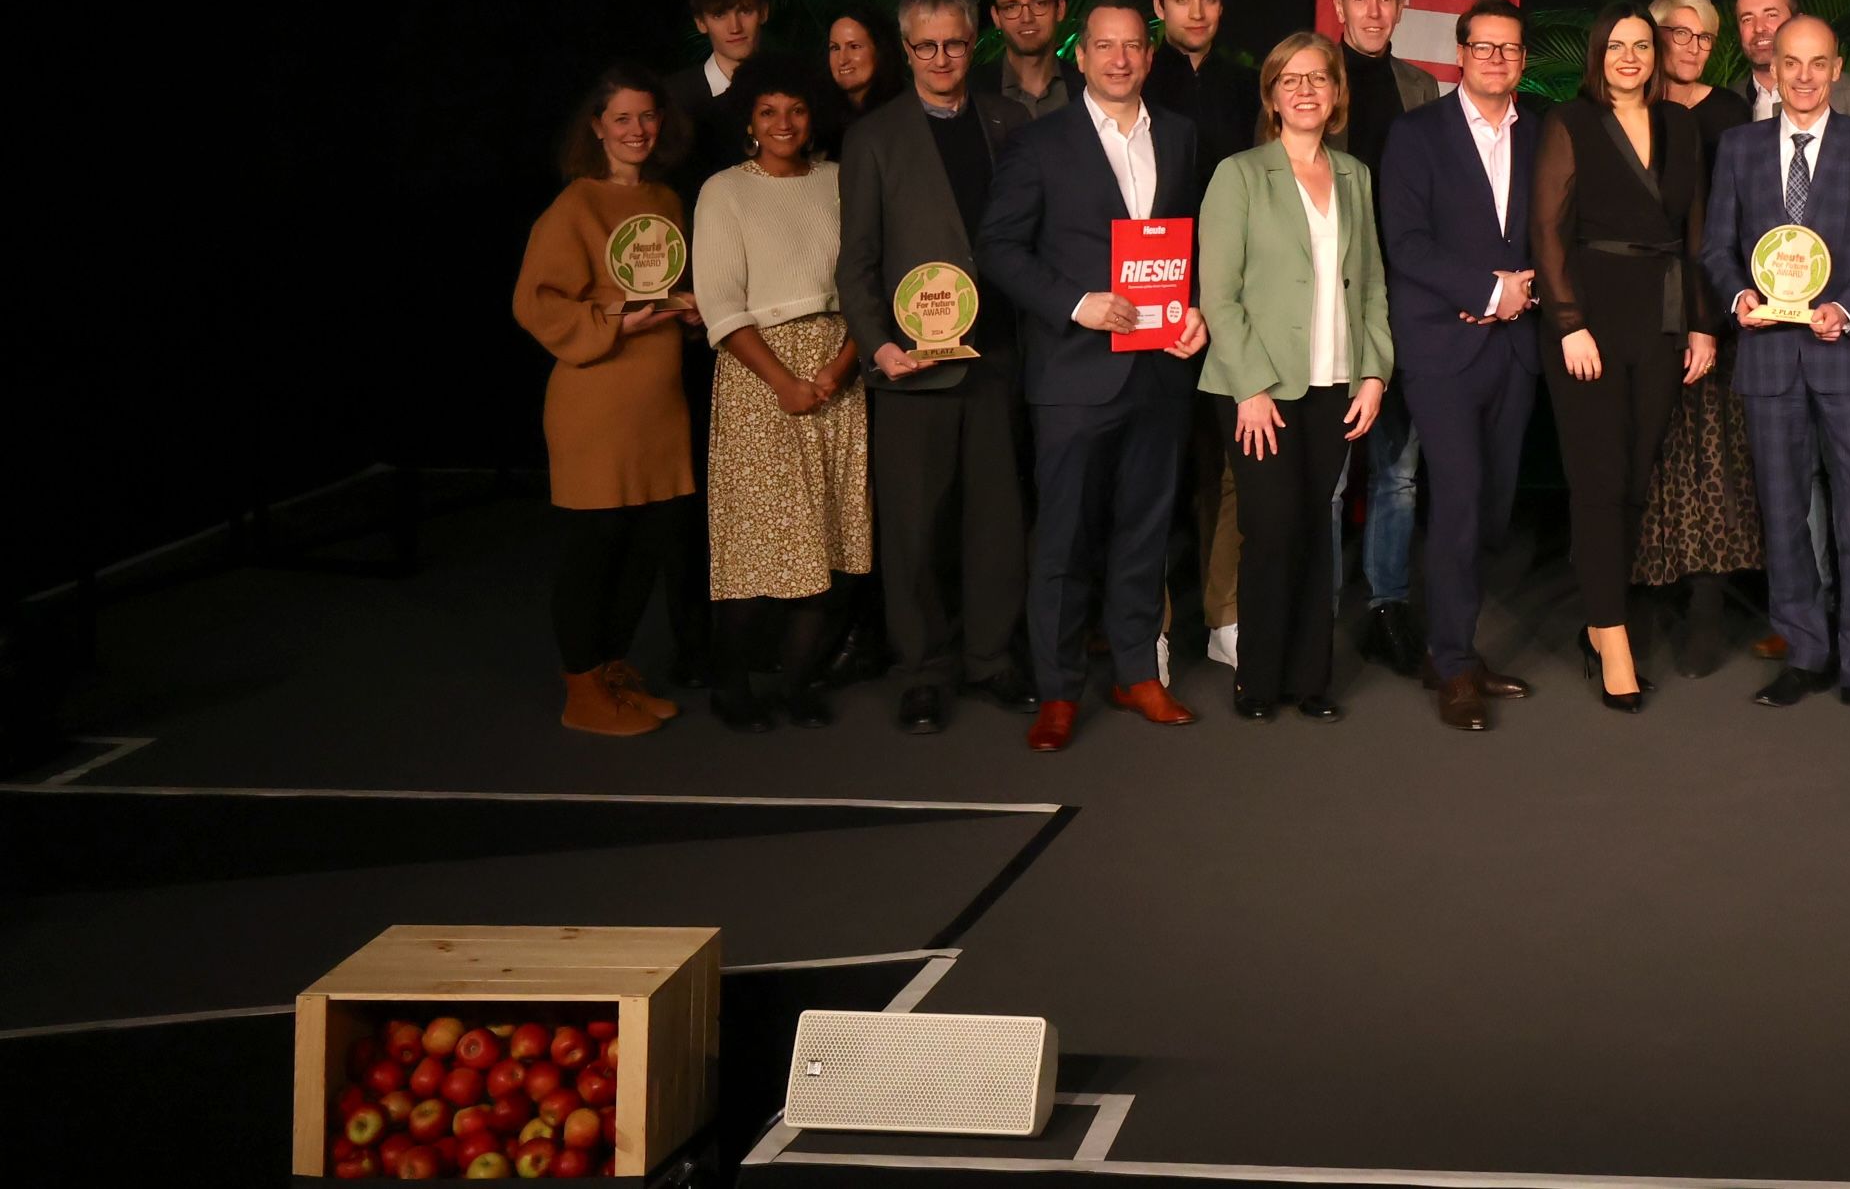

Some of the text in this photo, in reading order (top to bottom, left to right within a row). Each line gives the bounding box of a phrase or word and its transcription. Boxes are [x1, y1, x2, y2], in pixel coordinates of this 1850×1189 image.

[1143, 226, 1166, 235] Heute
[632, 242, 662, 253] Heute
[1776, 251, 1806, 263] Heute
[634, 259, 661, 268] AWARD
[1120, 259, 1187, 283] RIESIG!
[1776, 269, 1804, 279] AWARD
[920, 291, 951, 301] Heute
[916, 300, 956, 309] For Future
[922, 308, 951, 317] AWARD
[1779, 309, 1802, 317] PLATZ
[930, 348, 955, 356] PLATZ
